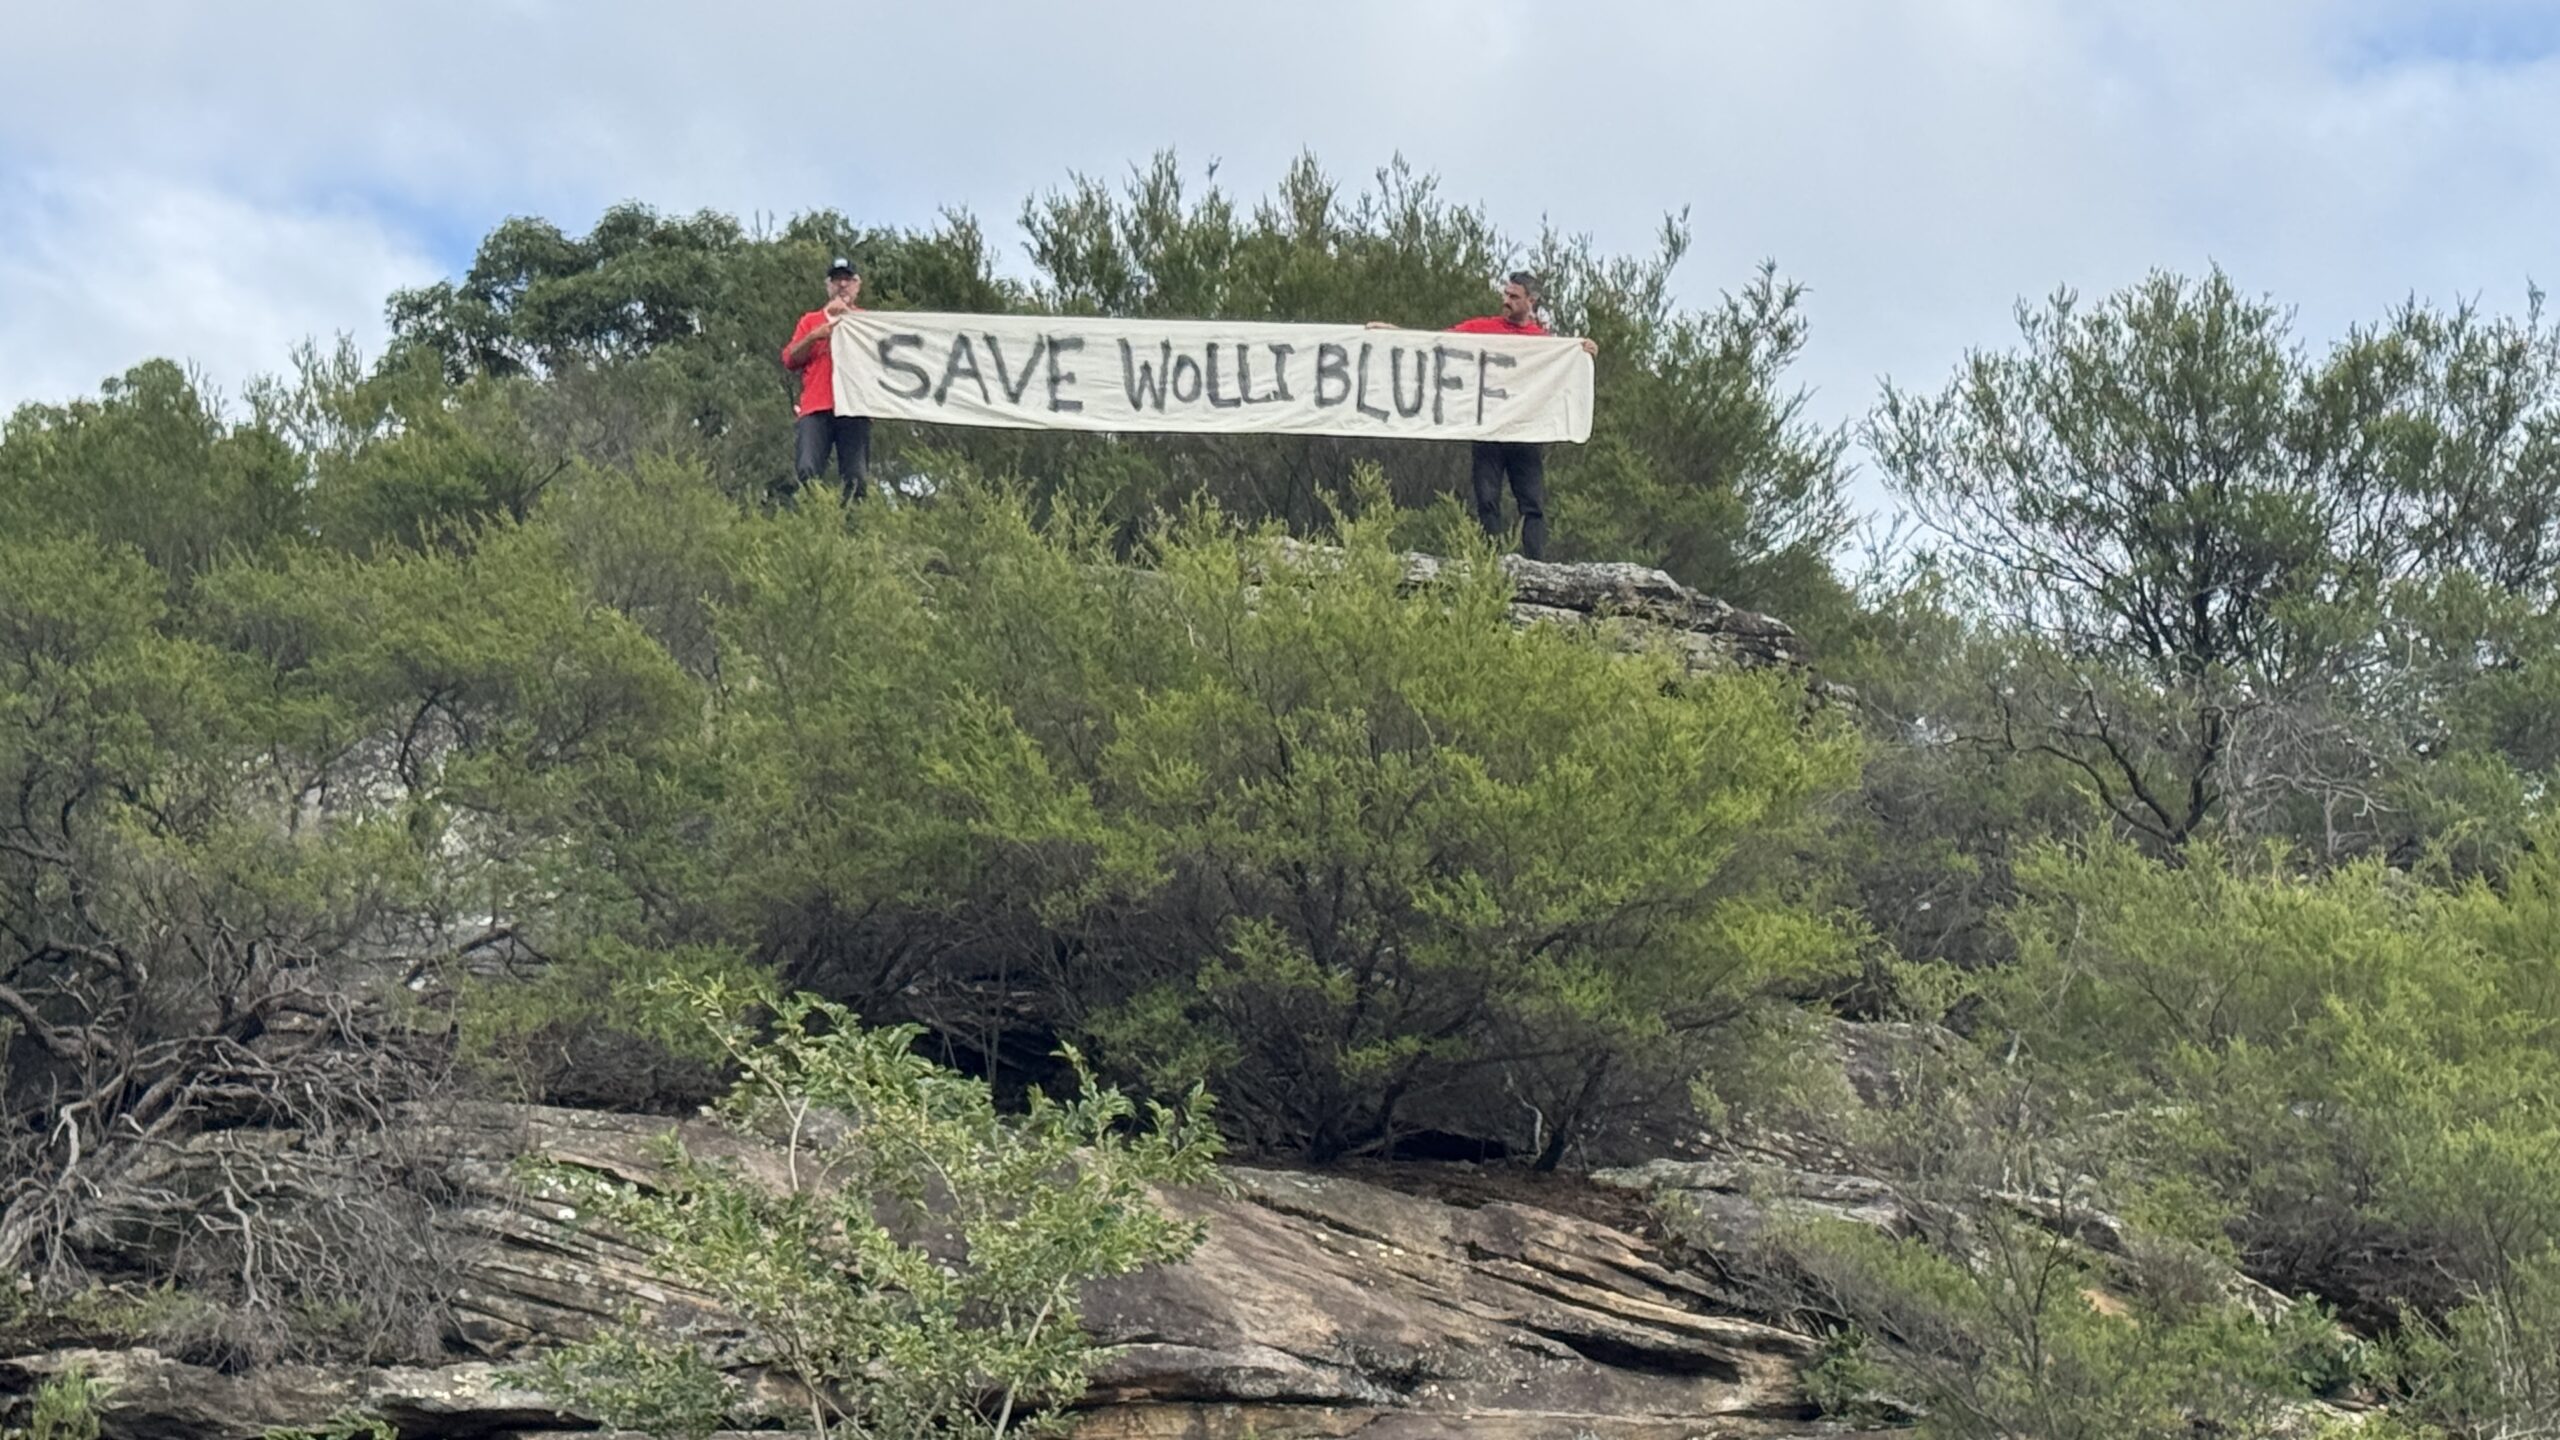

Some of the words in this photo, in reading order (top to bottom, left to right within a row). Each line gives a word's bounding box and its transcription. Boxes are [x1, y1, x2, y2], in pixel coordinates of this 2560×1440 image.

[878, 333, 1084, 412] SAVE
[1118, 338, 1295, 411] WOLLI
[1315, 342, 1517, 424] BLUFF
